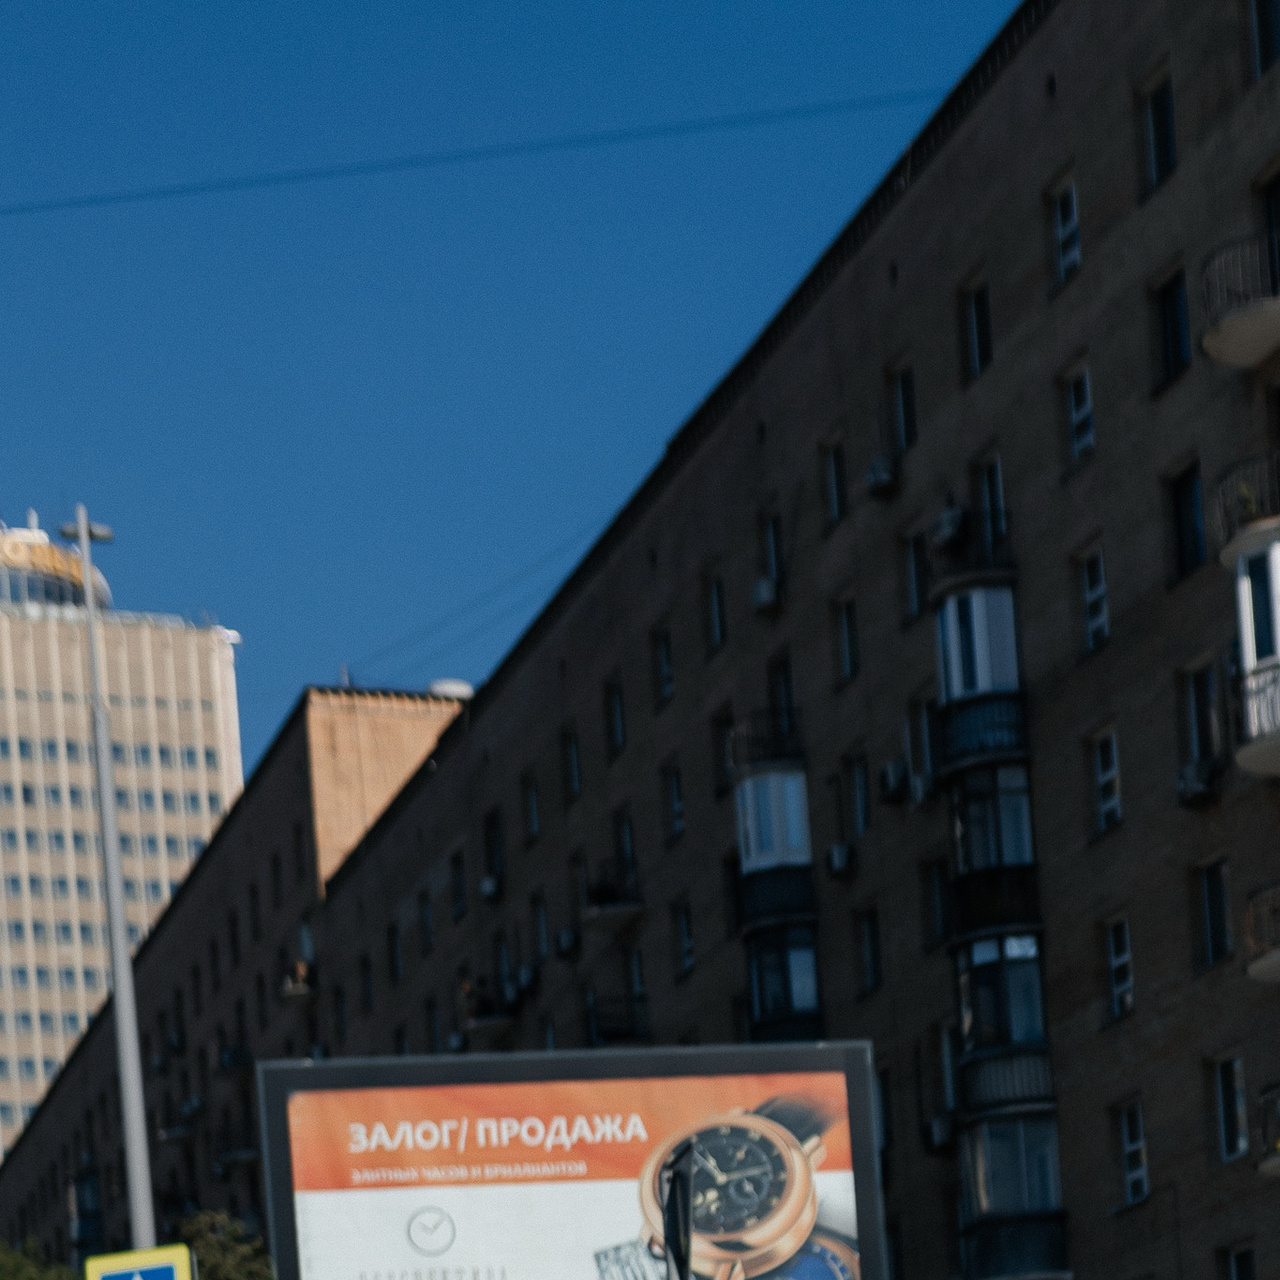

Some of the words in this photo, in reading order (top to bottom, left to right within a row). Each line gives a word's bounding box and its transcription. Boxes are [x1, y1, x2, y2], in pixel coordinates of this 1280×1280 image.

[348, 1117, 467, 1153] ЗАЛОГ/
[477, 1113, 648, 1151] ПРОДАЖА
[421, 1165, 468, 1180] ЧАСОВ
[470, 1165, 481, 1178] И
[484, 1160, 587, 1178] БРИЛЛИАНТОВ
